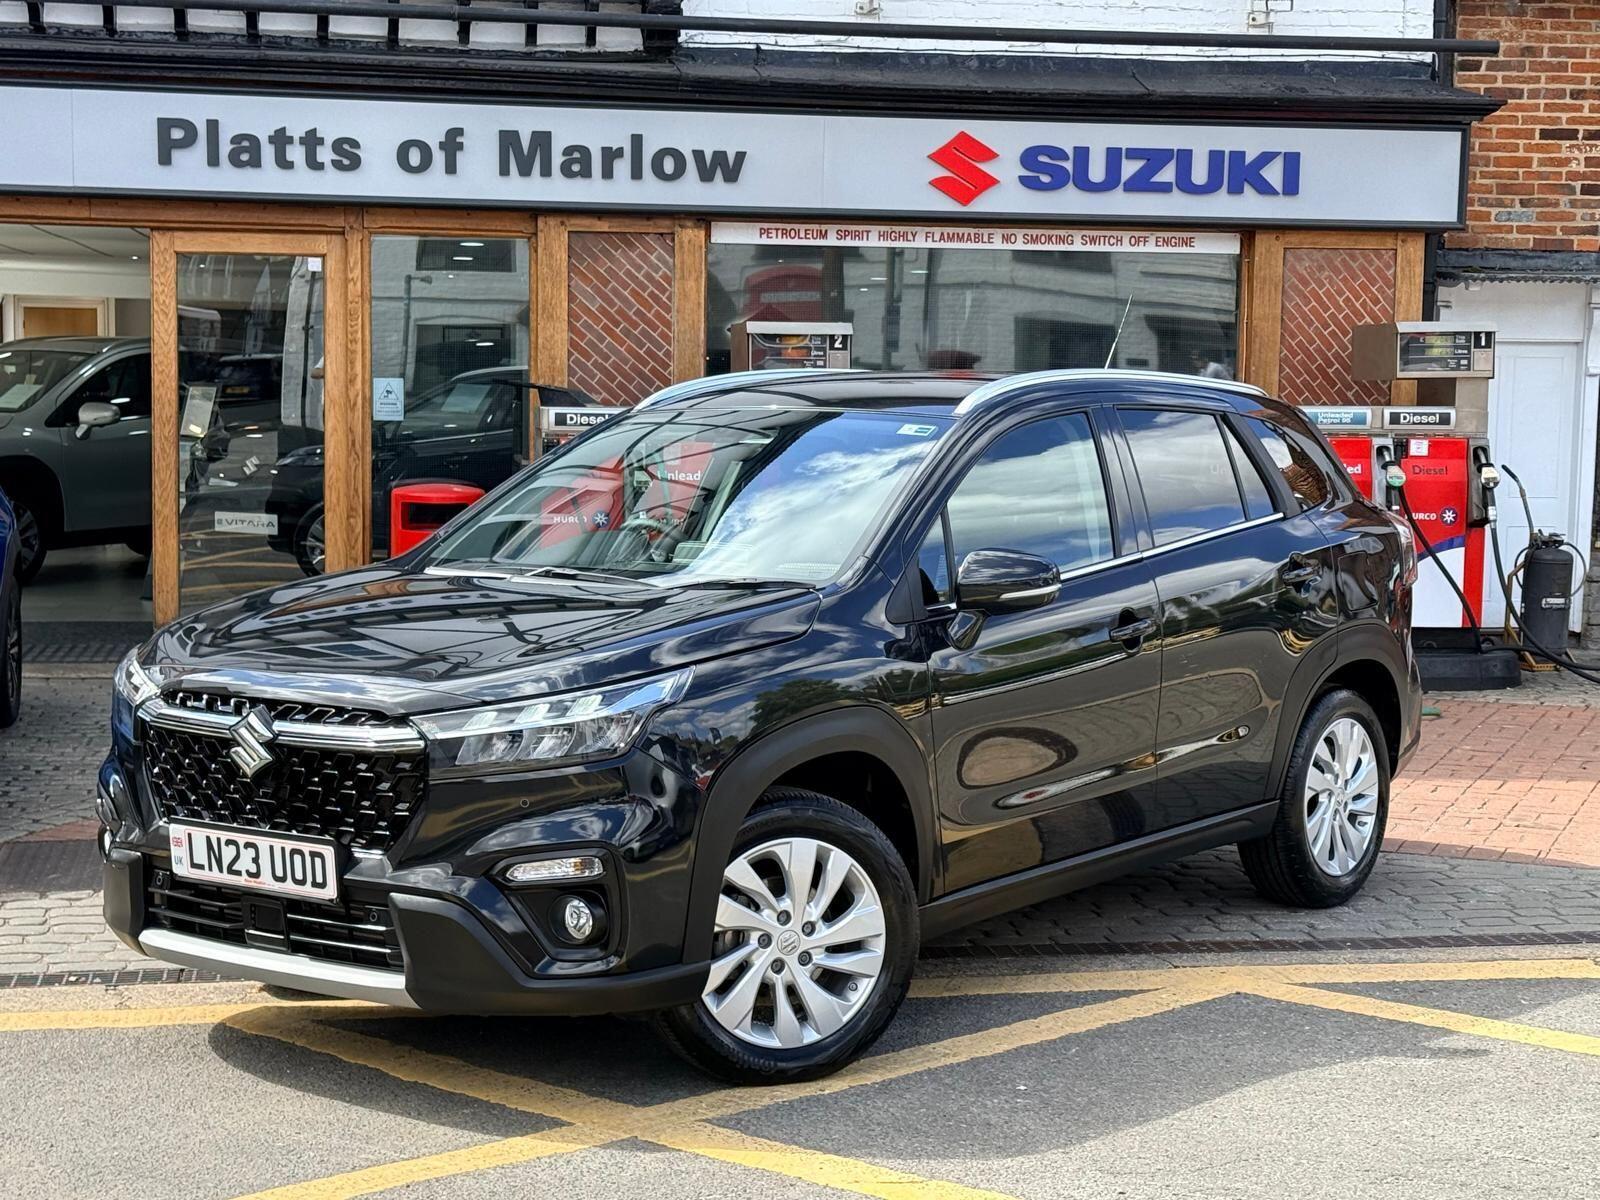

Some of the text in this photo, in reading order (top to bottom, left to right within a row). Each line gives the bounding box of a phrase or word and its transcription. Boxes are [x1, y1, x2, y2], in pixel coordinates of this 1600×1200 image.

[157, 117, 748, 183] Platts of Marlow
[1017, 144, 1301, 196] SUZUKI
[759, 227, 1195, 248] PETROLEUM SPIRIT HIGHLY FLAMMABLE NO SMOKING SWITCH OFF ENGINE
[833, 335, 843, 348] 2
[1479, 332, 1486, 347] 1
[1400, 413, 1440, 424] Diesel
[1412, 465, 1448, 476] Diesel
[1404, 512, 1437, 521] URCO
[174, 855, 184, 867] UK
[187, 832, 328, 890] LN23 UOD
